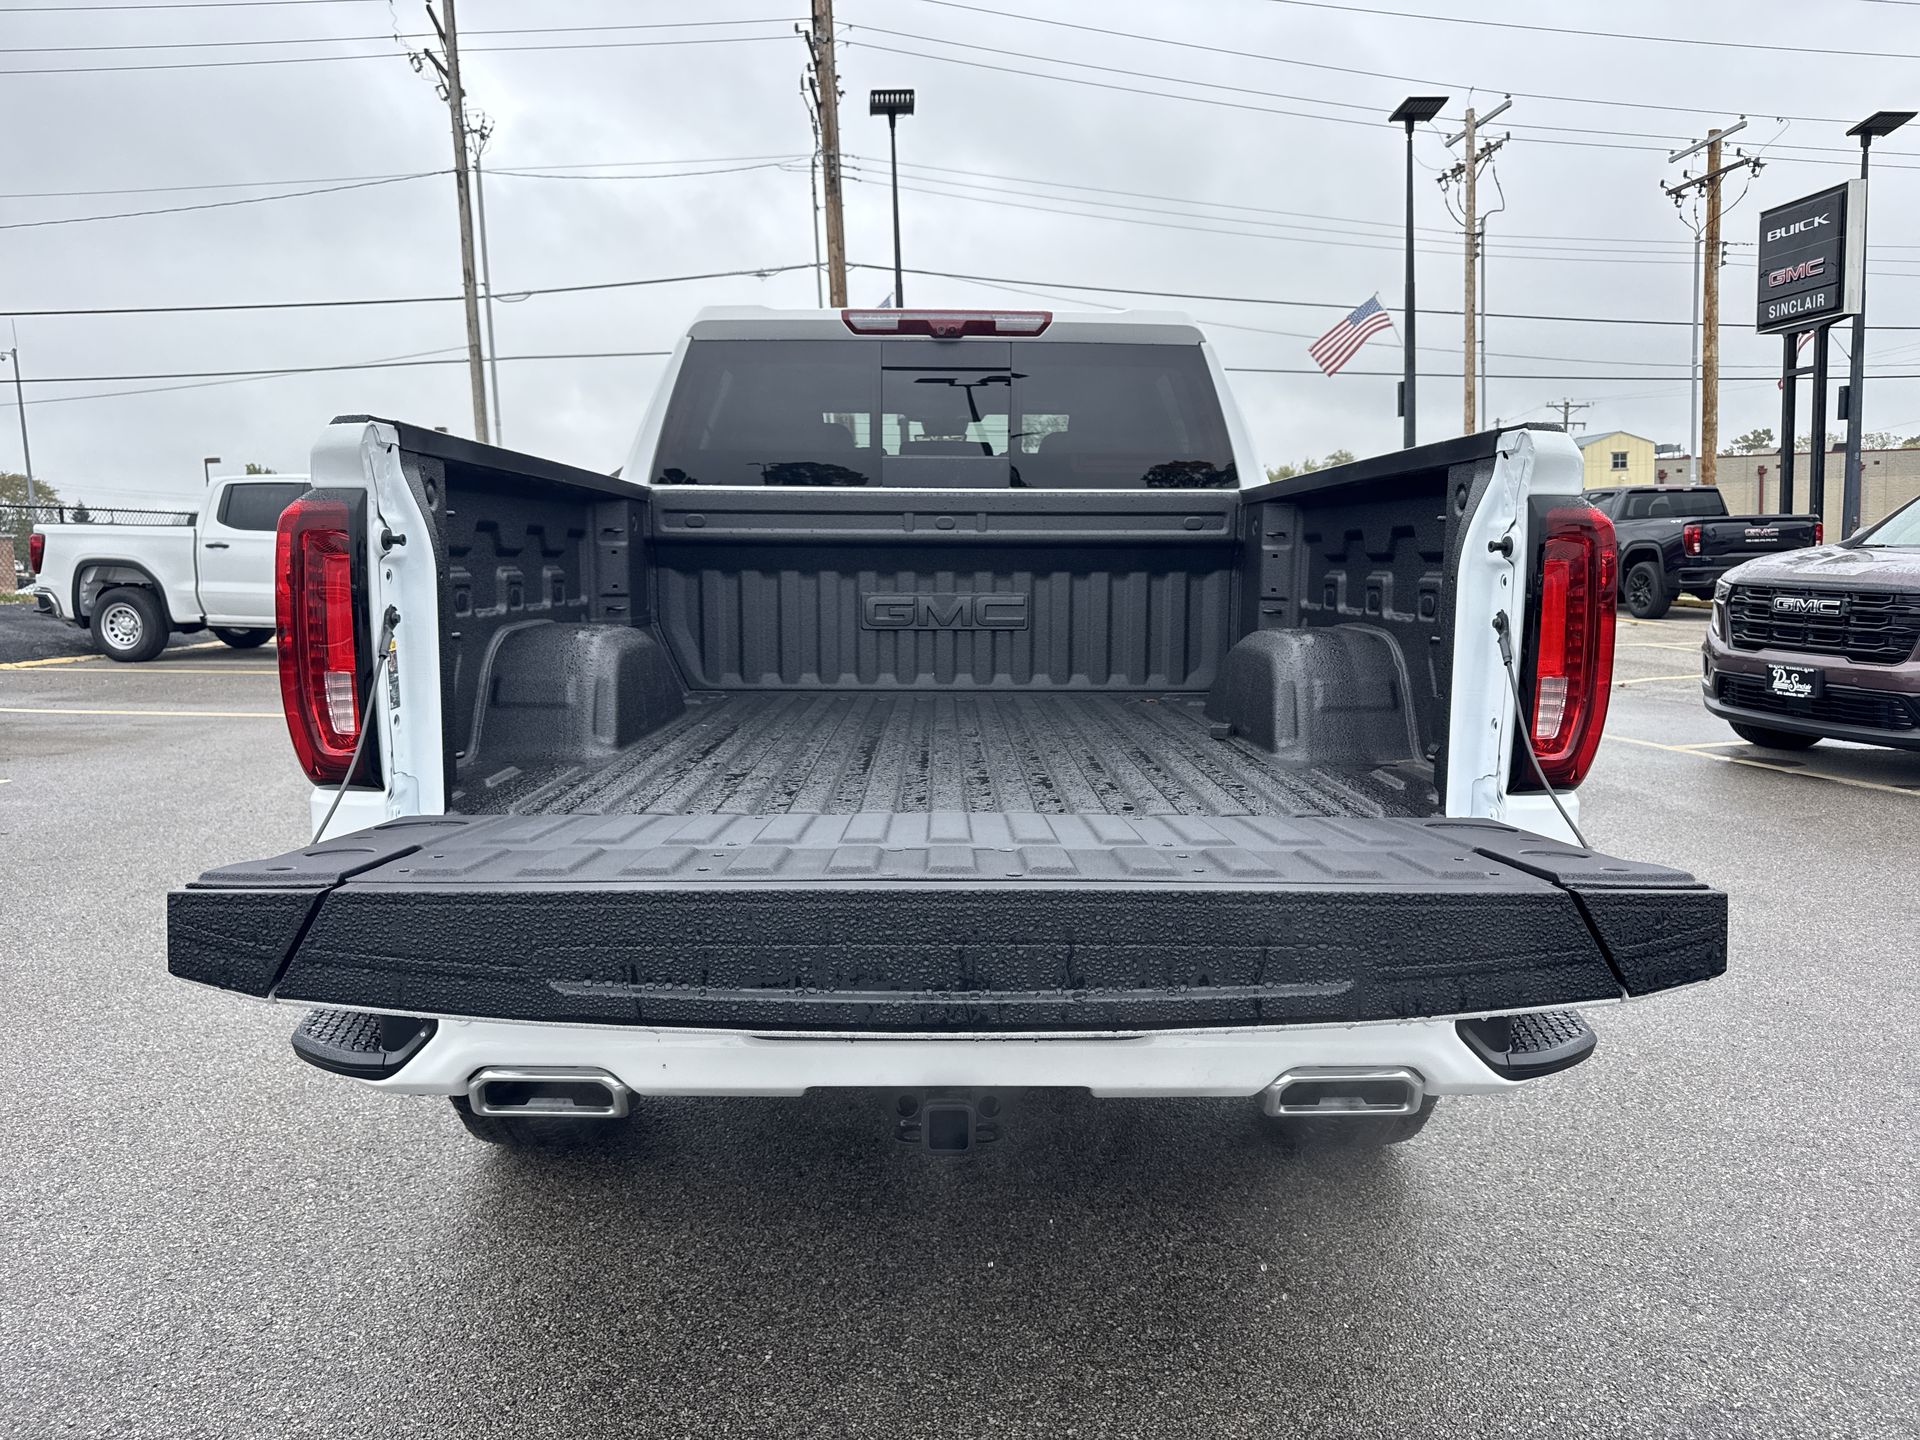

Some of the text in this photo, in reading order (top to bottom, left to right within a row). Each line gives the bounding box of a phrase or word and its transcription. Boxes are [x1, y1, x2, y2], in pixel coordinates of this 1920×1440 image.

[1767, 213, 1830, 242] BUICK
[1768, 257, 1825, 287] GMC
[1768, 293, 1825, 318] SINCLAIR
[864, 595, 1026, 627] GMC
[1773, 597, 1840, 614] GMC
